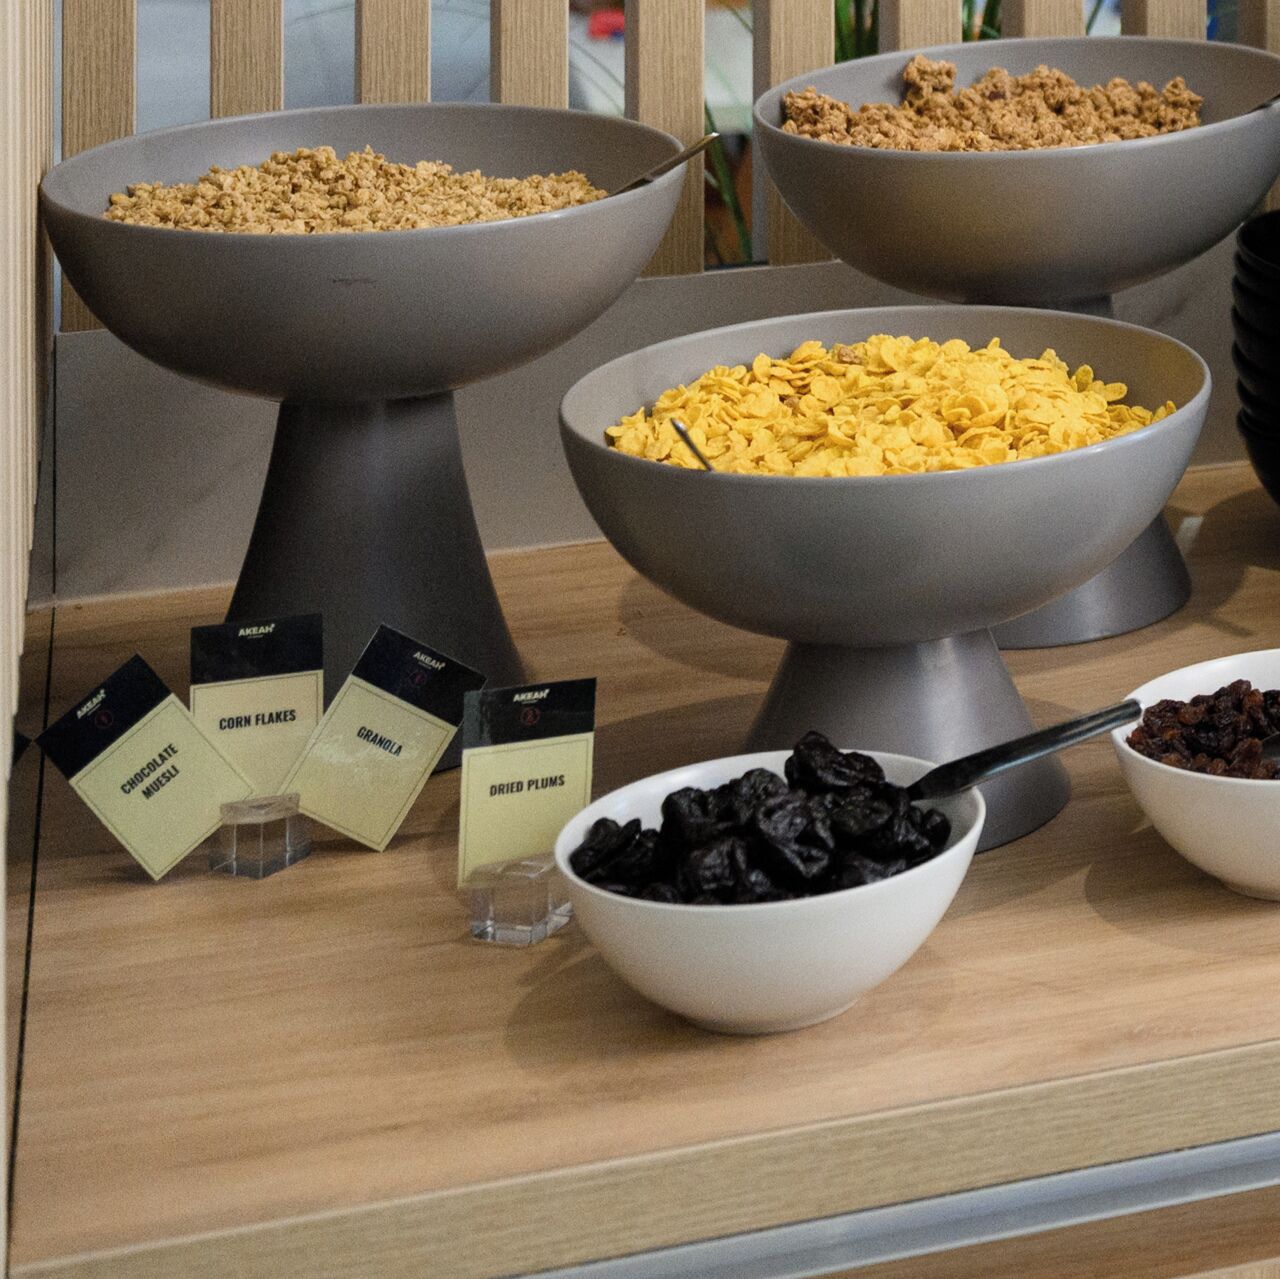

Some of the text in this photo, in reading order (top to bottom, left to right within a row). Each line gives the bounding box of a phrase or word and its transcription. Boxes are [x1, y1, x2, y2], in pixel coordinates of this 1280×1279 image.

[219, 709, 296, 731] CORN FLAKES
[357, 726, 403, 757] GRANOLA
[120, 743, 179, 795] CHOCOLATE
[142, 764, 180, 800] MUESLI
[489, 774, 565, 798] DRIED PLUMS
